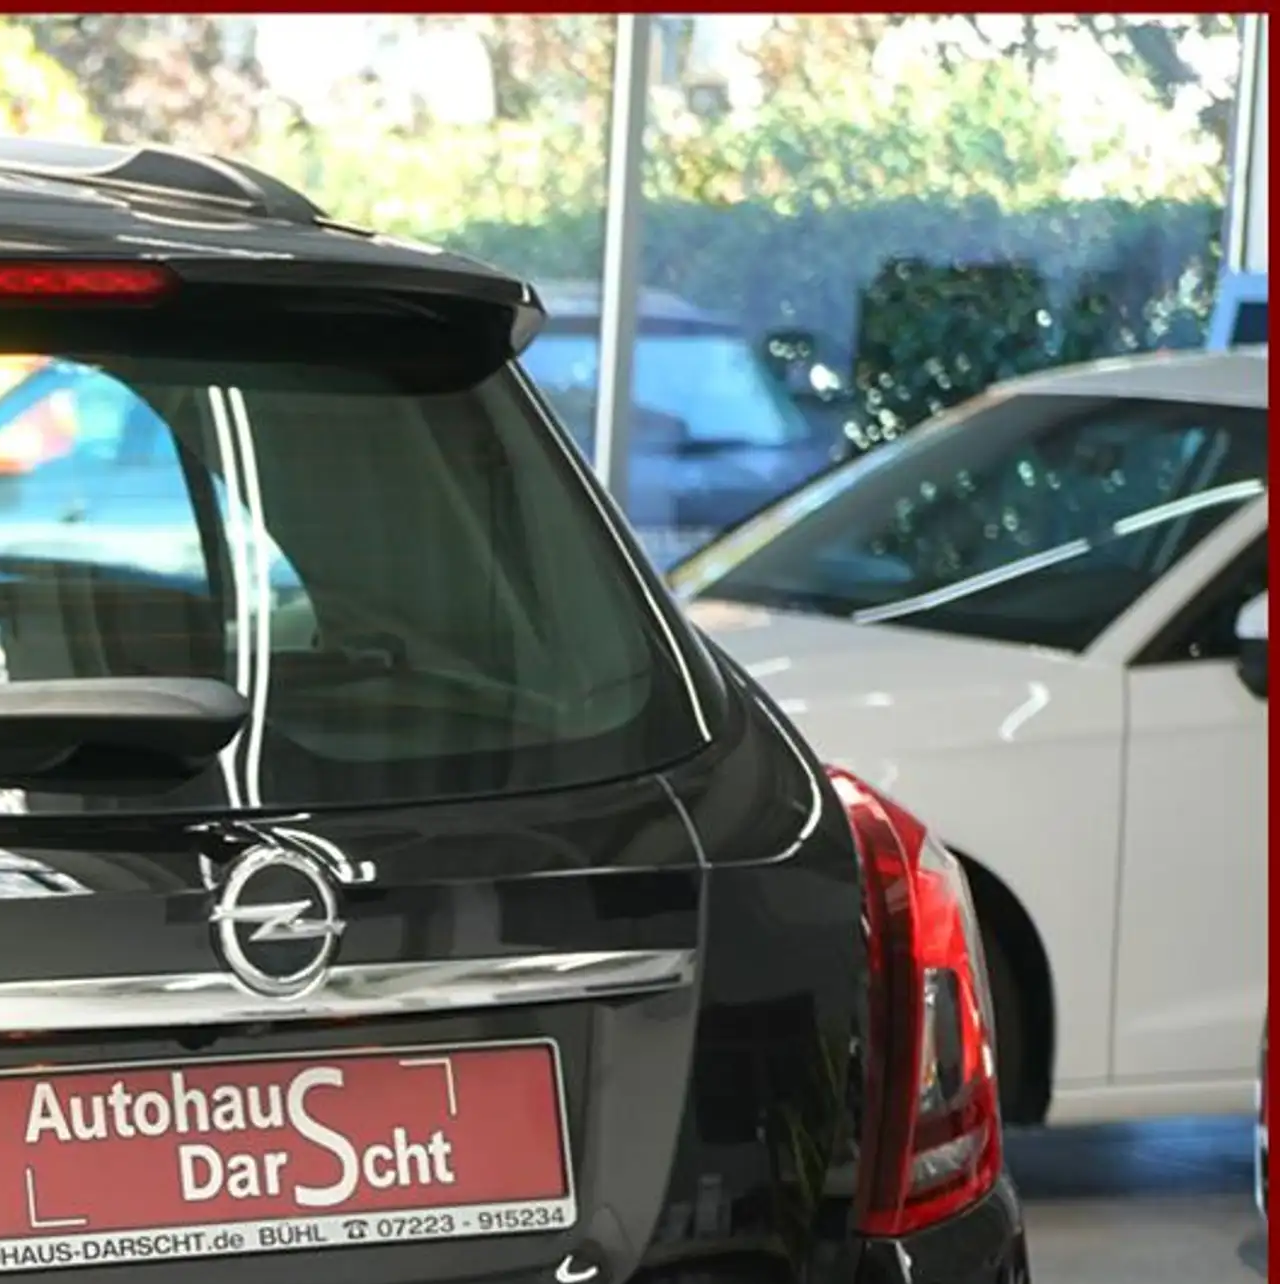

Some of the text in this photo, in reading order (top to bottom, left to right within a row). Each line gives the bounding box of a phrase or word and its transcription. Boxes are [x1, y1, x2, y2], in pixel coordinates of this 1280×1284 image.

[258, 1222, 327, 1246] BÜHL
[377, 1213, 455, 1237] 07223
[477, 1206, 565, 1230] 915234
